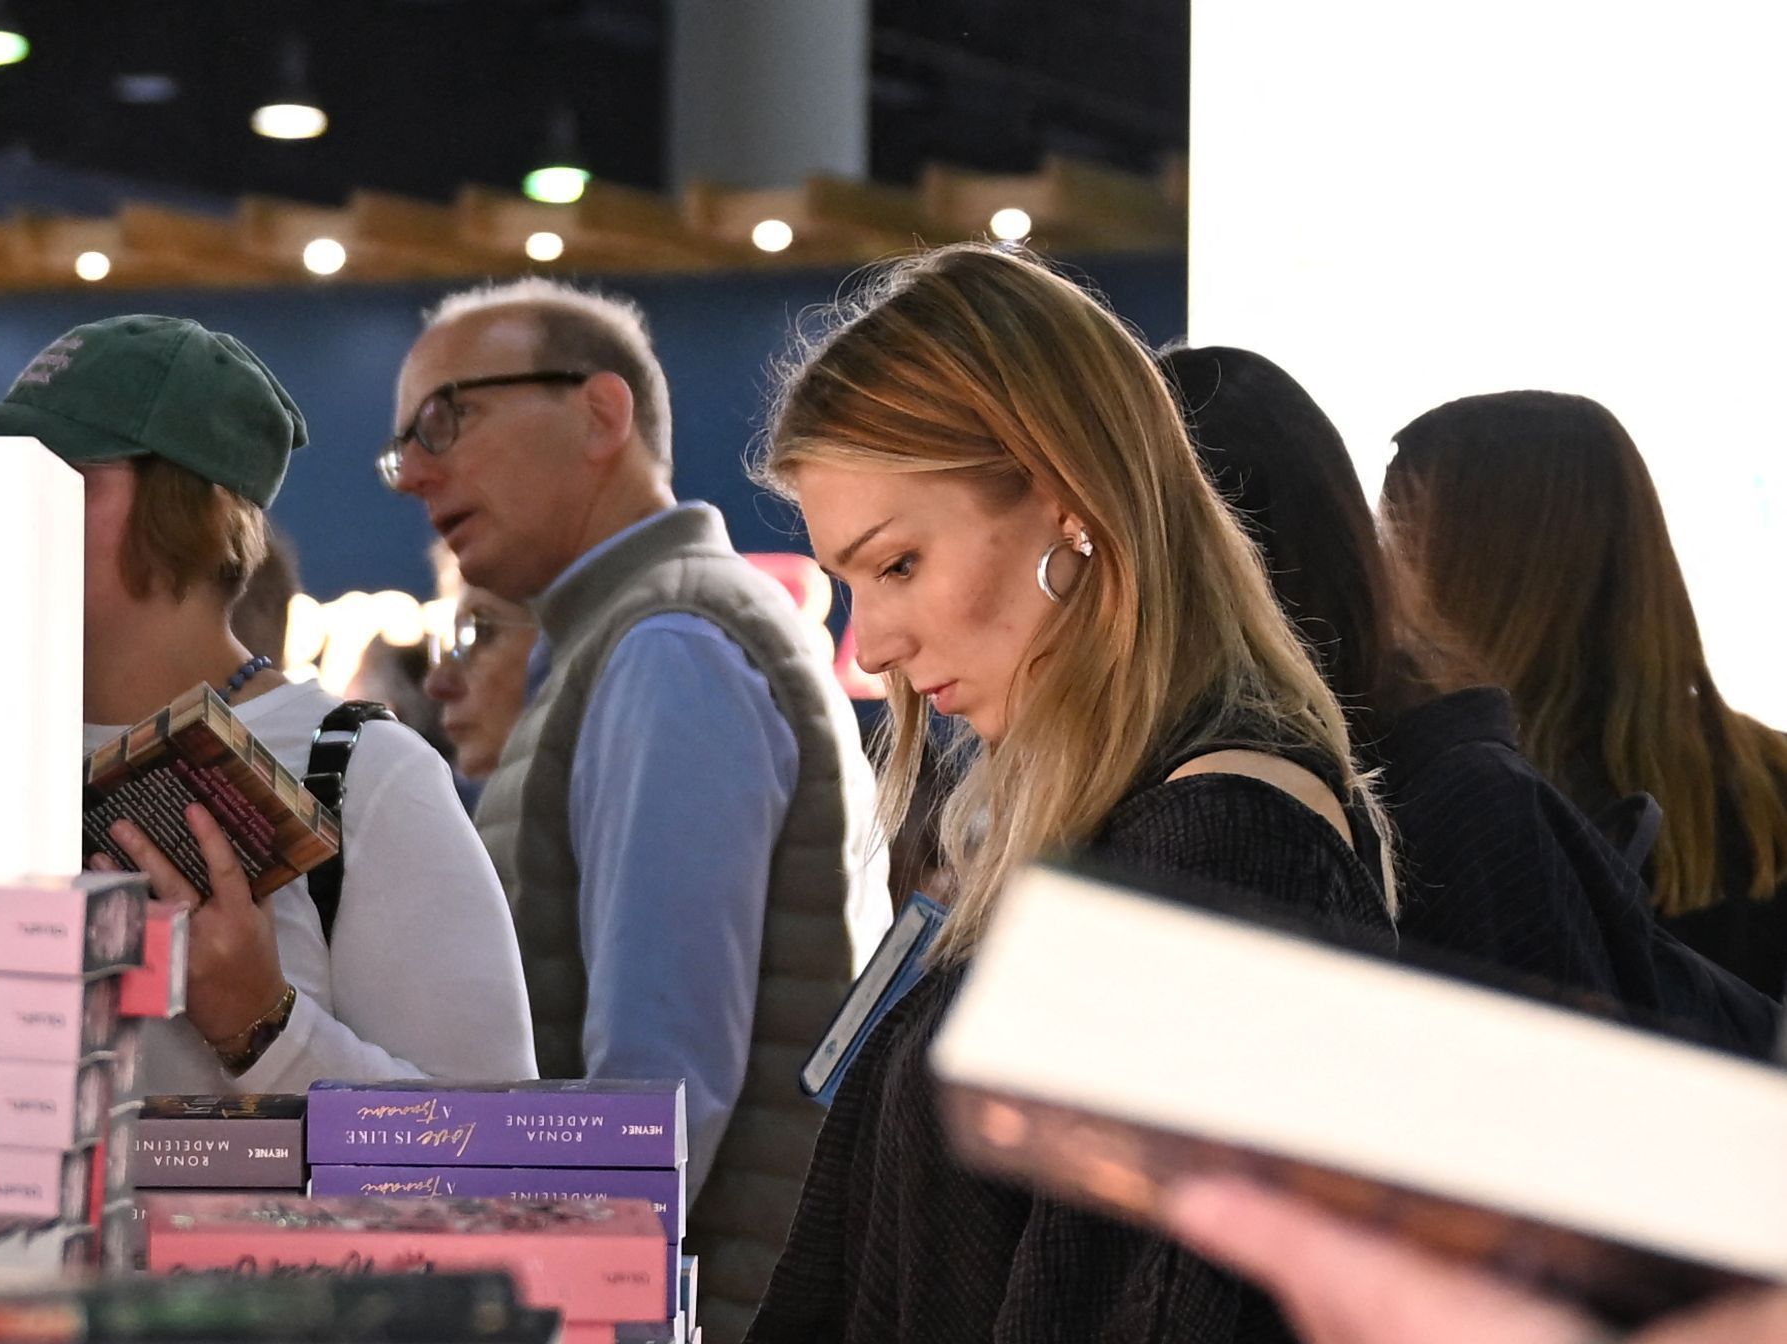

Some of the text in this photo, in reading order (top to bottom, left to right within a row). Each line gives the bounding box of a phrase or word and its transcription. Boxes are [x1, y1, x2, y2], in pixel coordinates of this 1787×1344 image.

[357, 1098, 452, 1124] A Tsunami
[505, 1114, 603, 1127] MADELEINE
[526, 1130, 582, 1142] RONJA
[628, 1125, 663, 1135] HEYNE
[345, 1121, 477, 1157] Love IS LIKE
[254, 1148, 289, 1158] HEYNE
[153, 1155, 209, 1166] RONJA
